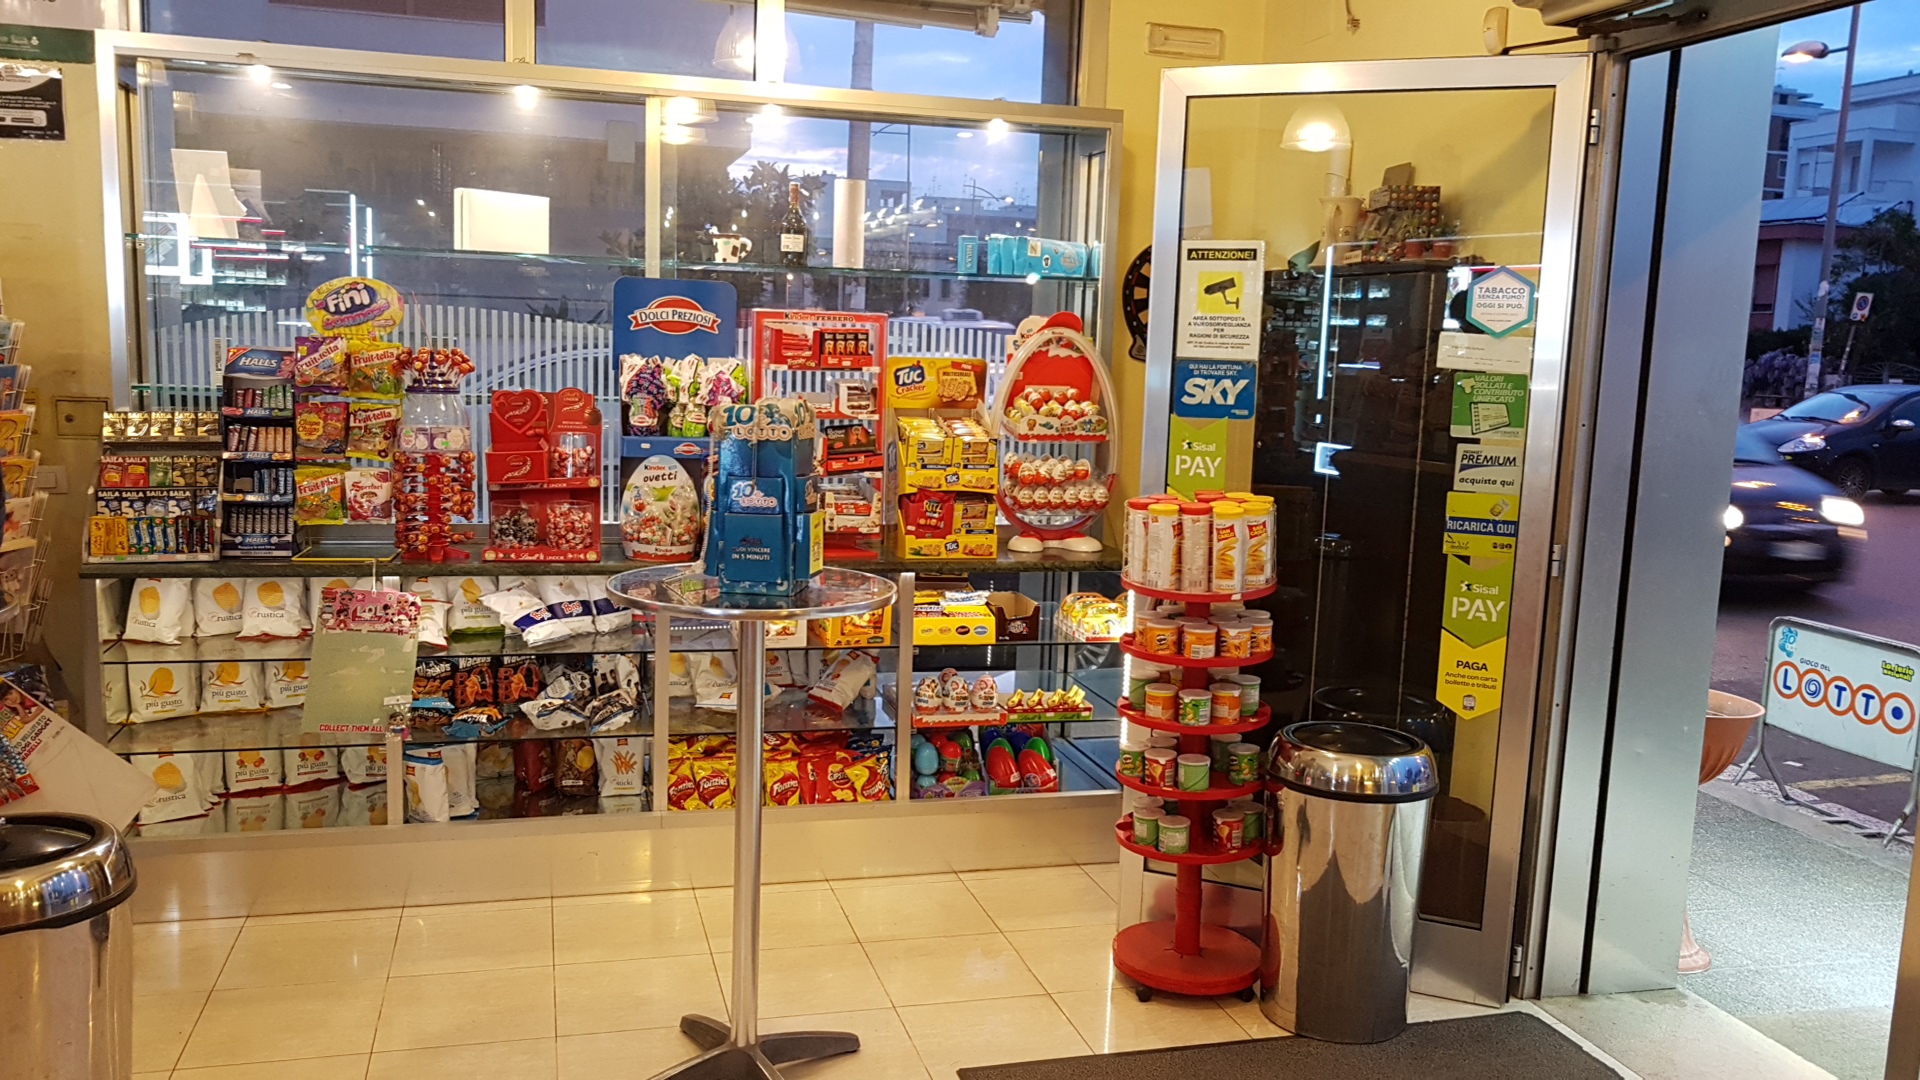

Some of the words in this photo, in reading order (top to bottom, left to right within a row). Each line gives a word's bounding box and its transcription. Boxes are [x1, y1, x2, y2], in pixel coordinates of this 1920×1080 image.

[1189, 250, 1255, 259] ATTENZIONE!
[1478, 286, 1526, 295] TABACCO
[1506, 301, 1525, 309] PUÒ.
[639, 309, 670, 323] DOLCI
[671, 309, 711, 326] PREZIOSI
[785, 312, 809, 320] Kinder
[239, 356, 278, 369] HALLS
[352, 350, 395, 366] Fruit-tella
[1199, 363, 1209, 371] HAI
[896, 366, 923, 385] TUC
[895, 384, 927, 395] Cracker
[1180, 377, 1250, 405] SKY
[1473, 389, 1524, 397] CONTRIBUTO
[723, 405, 757, 425] 10
[735, 427, 790, 439] LOTTO
[1192, 441, 1216, 452] Sisal
[1460, 453, 1517, 467] PREMIUM
[1175, 455, 1222, 478] PAY
[643, 471, 678, 483] ovetti
[1458, 476, 1498, 486] acquista
[1499, 479, 1515, 487] qui
[732, 482, 756, 499] 10
[741, 497, 777, 507] LOTTO
[923, 500, 943, 513] RITZ
[1446, 520, 1495, 533] RICARICA
[1496, 523, 1515, 535] QUI
[1217, 532, 1235, 540] CARLO
[1472, 584, 1499, 595] Sisal
[256, 610, 285, 618] rustica
[1451, 596, 1506, 622] PAY
[217, 613, 243, 622] rustica
[134, 619, 157, 628] rustica
[1783, 633, 1796, 645] 10
[1455, 660, 1489, 672] PAGA
[1799, 657, 1819, 668] GIOCO
[1444, 671, 1466, 679] Anche
[1466, 673, 1480, 681] con
[1480, 675, 1498, 683] carta
[280, 684, 293, 694] più
[1444, 678, 1471, 687] bollette
[1476, 681, 1497, 690] tributi
[211, 688, 225, 698] più
[225, 689, 247, 699] gusto
[1778, 664, 1910, 728] LOTTO
[145, 699, 160, 710] più
[160, 699, 183, 709] gusto
[30, 717, 53, 742] GADGET
[319, 723, 351, 732] COLLECT
[351, 724, 370, 732] THEM
[297, 761, 309, 771] più
[310, 760, 329, 770] gusto
[365, 763, 377, 773] più
[235, 768, 248, 779] più
[249, 767, 270, 777] gusto
[699, 778, 728, 790] Fonzies
[772, 778, 799, 794] Fonzies
[158, 793, 187, 803] rustica
